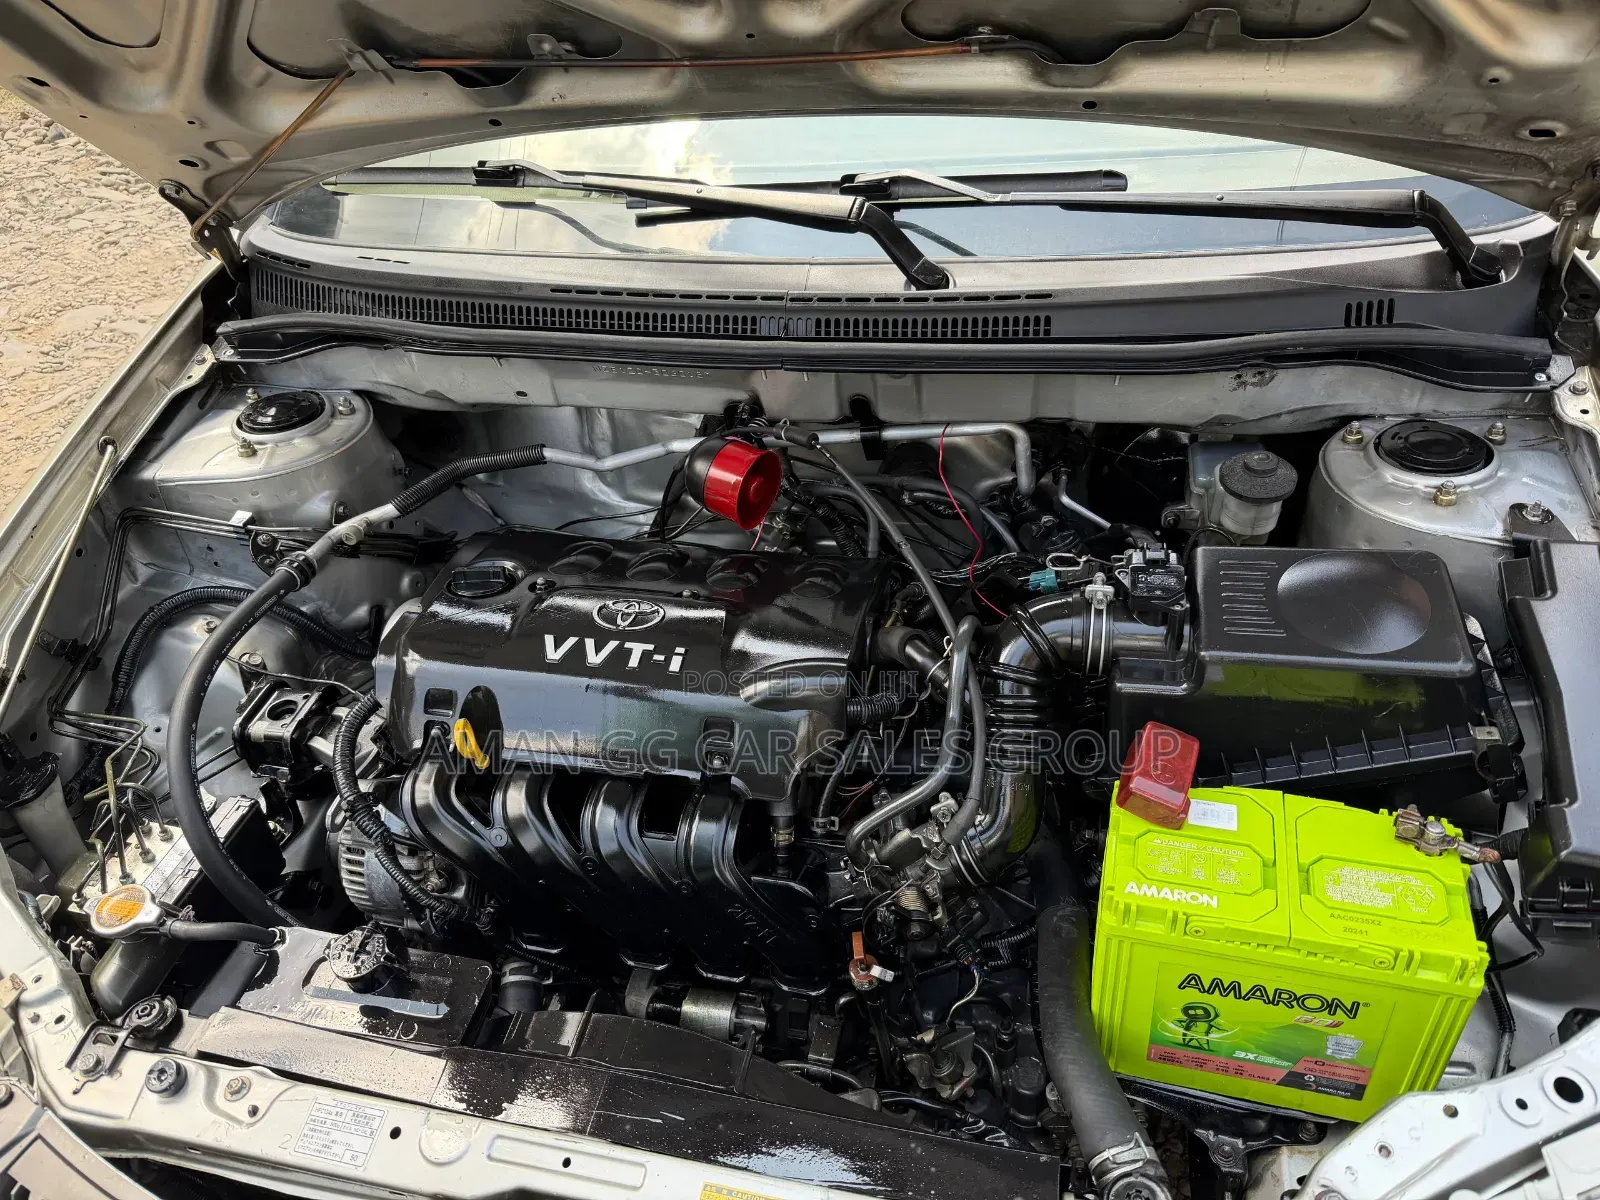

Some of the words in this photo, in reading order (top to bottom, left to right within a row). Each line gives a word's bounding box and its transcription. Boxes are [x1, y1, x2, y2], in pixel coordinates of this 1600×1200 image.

[544, 634, 687, 674] VVT-i
[1162, 838, 1198, 850] DANGER
[1206, 845, 1244, 857] CAUTION
[1124, 881, 1218, 909] AMARON
